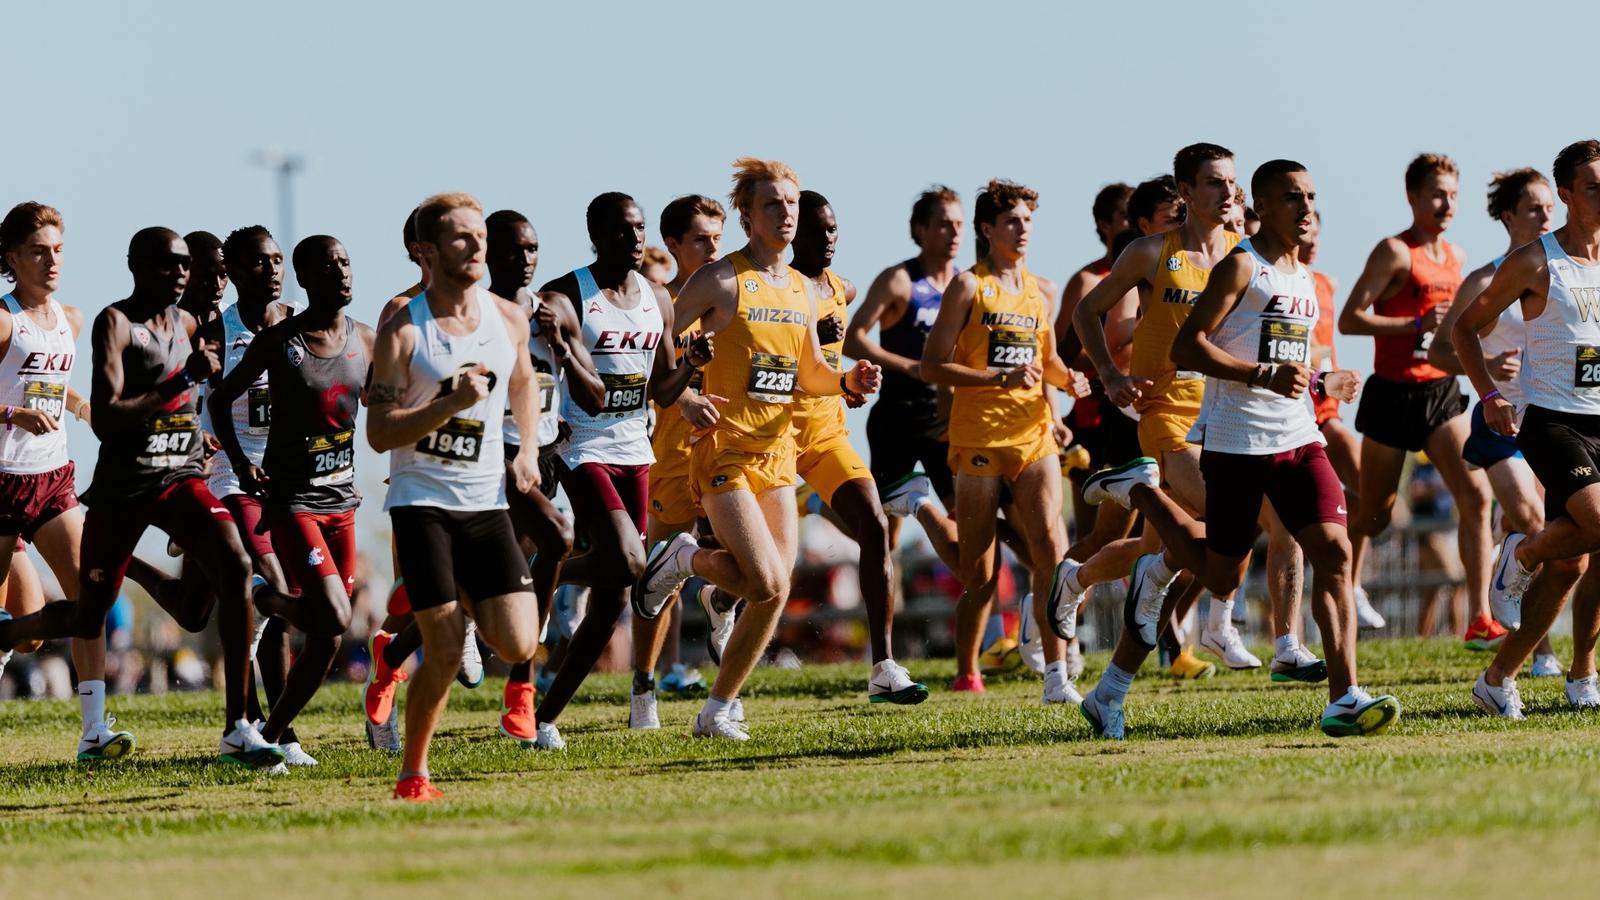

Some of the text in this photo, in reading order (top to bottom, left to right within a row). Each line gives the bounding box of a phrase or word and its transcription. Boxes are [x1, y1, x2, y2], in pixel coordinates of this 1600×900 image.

[1263, 295, 1315, 317] EKU
[594, 331, 660, 350] EKU
[1268, 339, 1306, 362] 1993
[21, 352, 73, 371] EKU
[993, 346, 1034, 365] 2233
[755, 371, 794, 392] 2235
[604, 389, 641, 407] 1995
[146, 432, 192, 453] 2647
[428, 430, 477, 457] 1943
[315, 449, 351, 472] 2645
